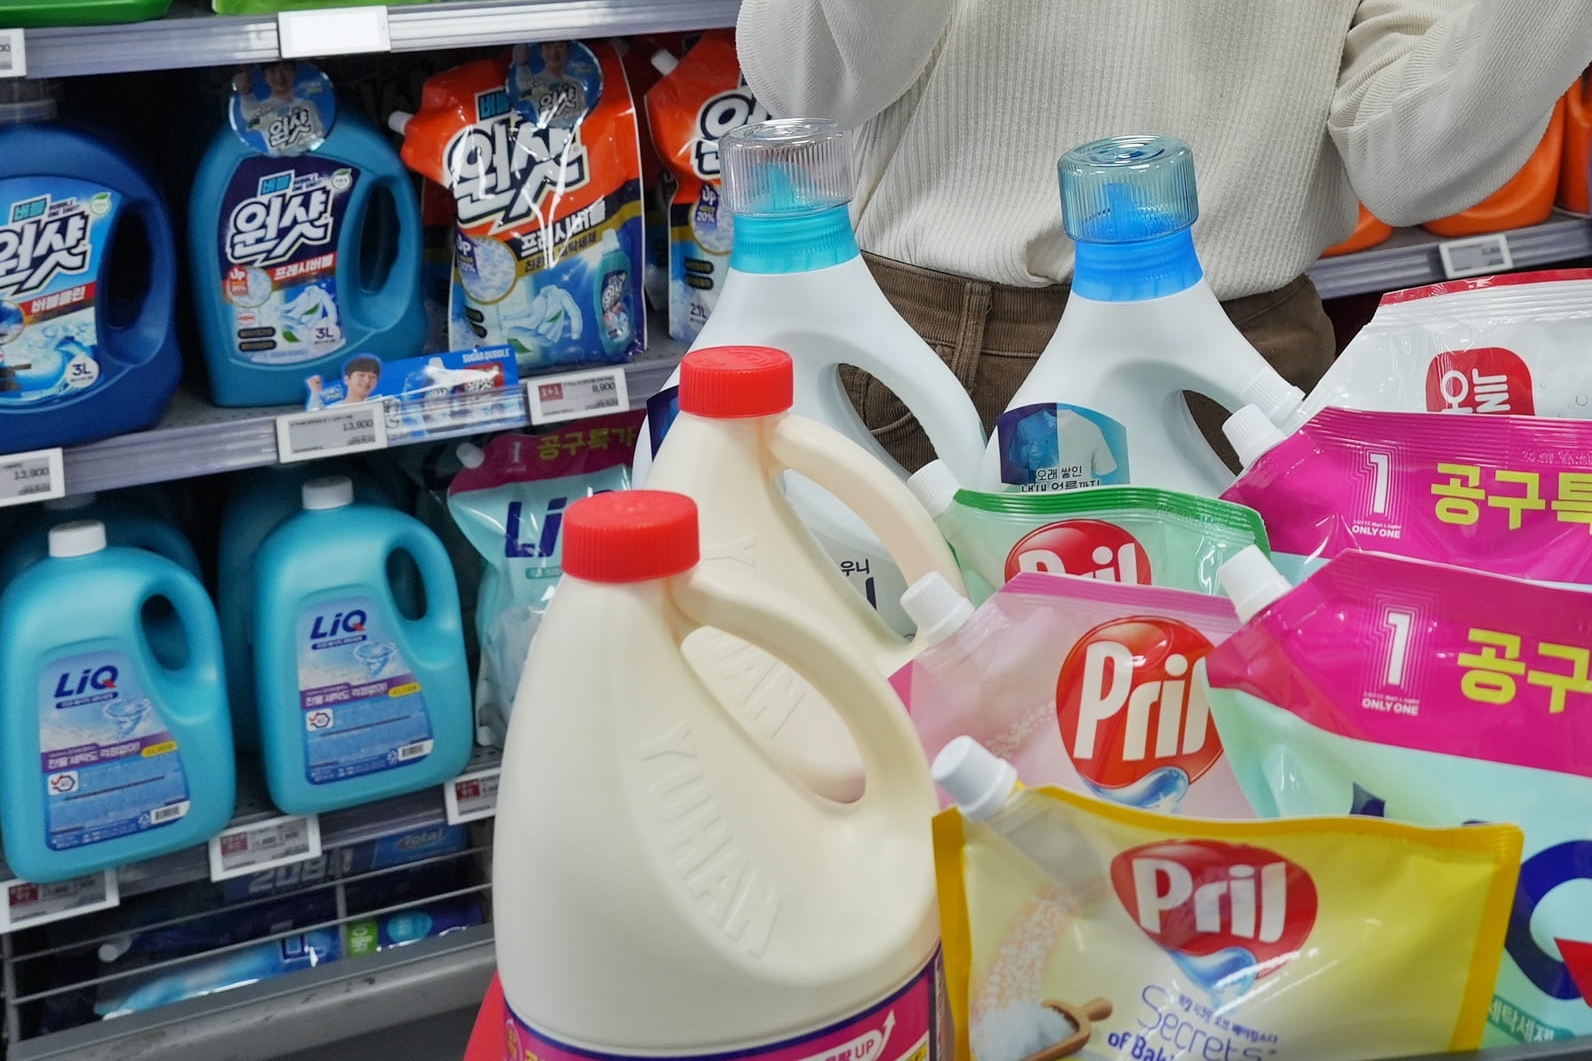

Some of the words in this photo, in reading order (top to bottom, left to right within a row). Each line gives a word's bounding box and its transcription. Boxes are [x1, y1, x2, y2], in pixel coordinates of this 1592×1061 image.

[446, 122, 582, 228] 원샷
[232, 190, 332, 264] 원샷
[0, 215, 88, 294] 원샷
[315, 327, 334, 340] 3L
[71, 363, 92, 377] 3L
[1036, 468, 1059, 482] 오래
[1351, 524, 1380, 538] ONLY
[1379, 526, 1402, 540] ONE
[310, 609, 368, 640] LiQ
[53, 664, 119, 699] LiQ
[1073, 639, 1216, 762] Pril
[1361, 698, 1395, 714] ONLY
[1393, 700, 1420, 717] ONE
[1131, 856, 1289, 945] Pril
[1137, 984, 1264, 1061] Secrets
[854, 1037, 877, 1061] UP
[1107, 1031, 1132, 1050] of
